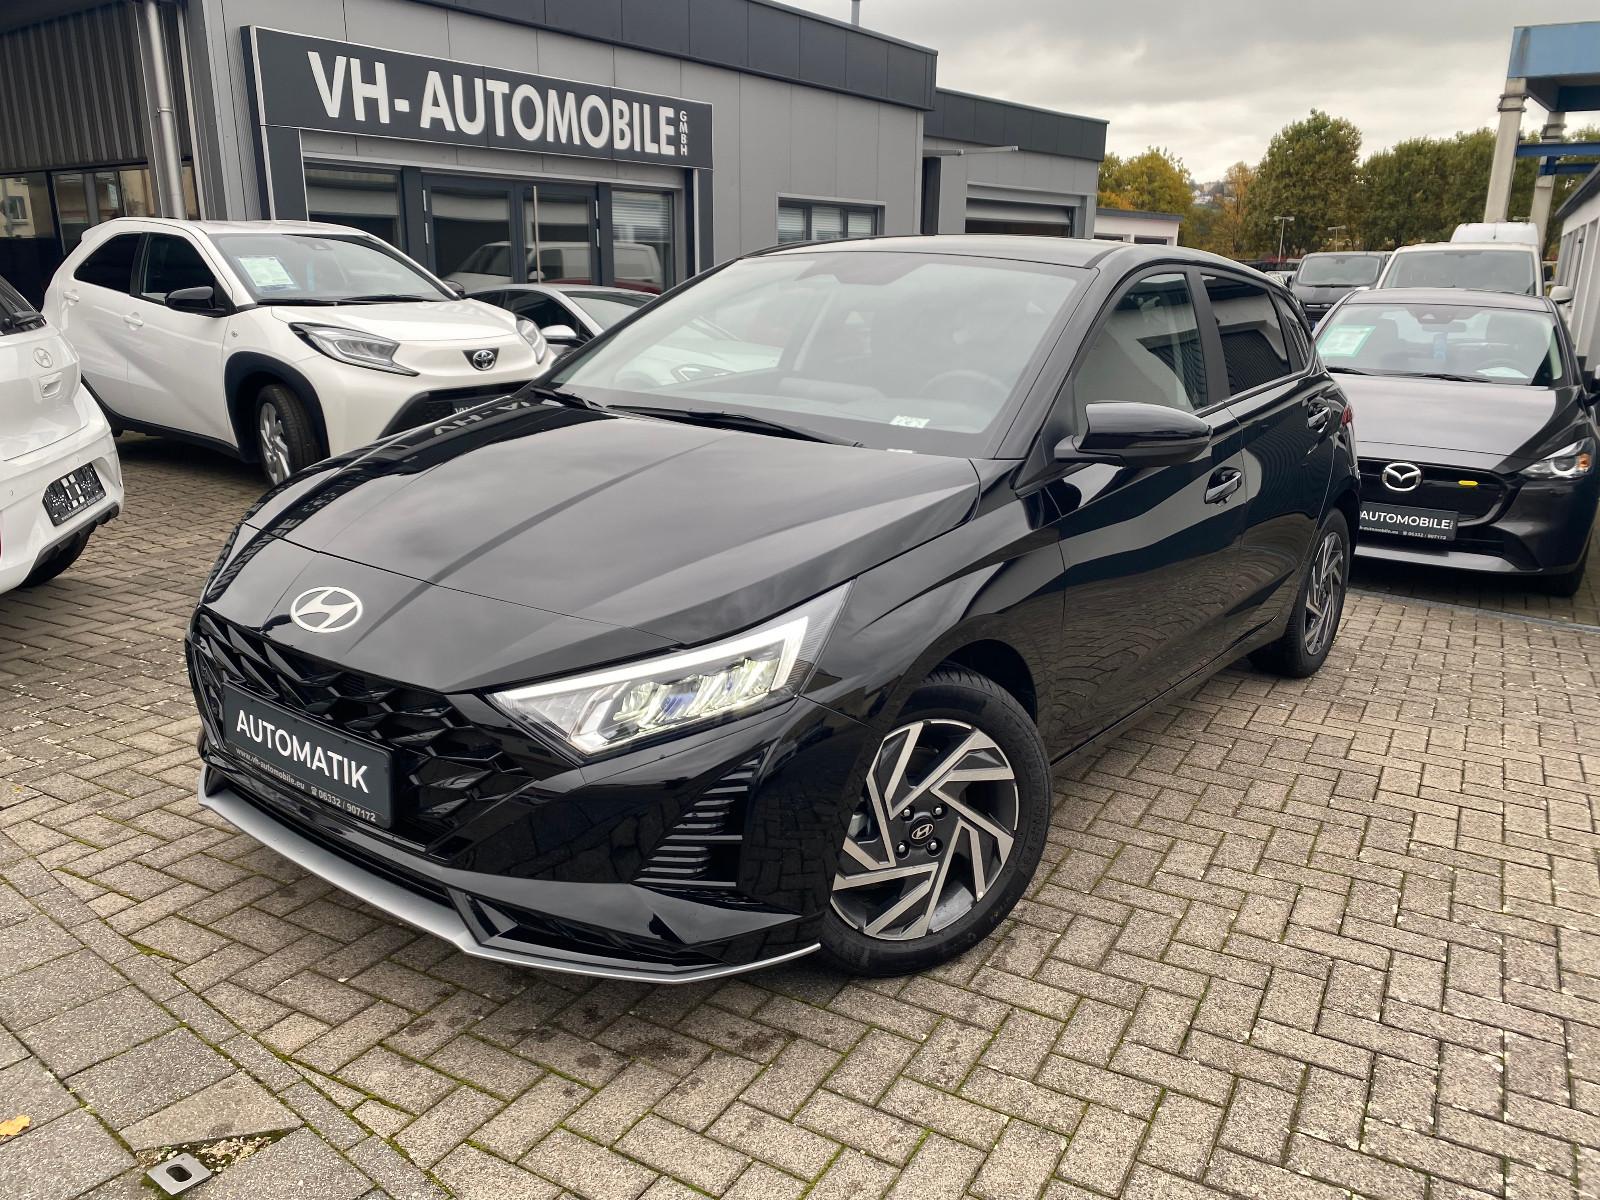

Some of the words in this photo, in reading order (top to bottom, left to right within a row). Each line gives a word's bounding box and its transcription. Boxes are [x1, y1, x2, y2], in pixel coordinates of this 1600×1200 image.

[307, 51, 410, 124] VH-
[419, 70, 676, 156] AUTOMOBILE
[679, 110, 688, 156] GMBH
[235, 746, 305, 790] www.vh-automobile.eu
[318, 789, 341, 807] 06332
[346, 803, 376, 822] 907172
[236, 709, 369, 794] AUTOMATIK
